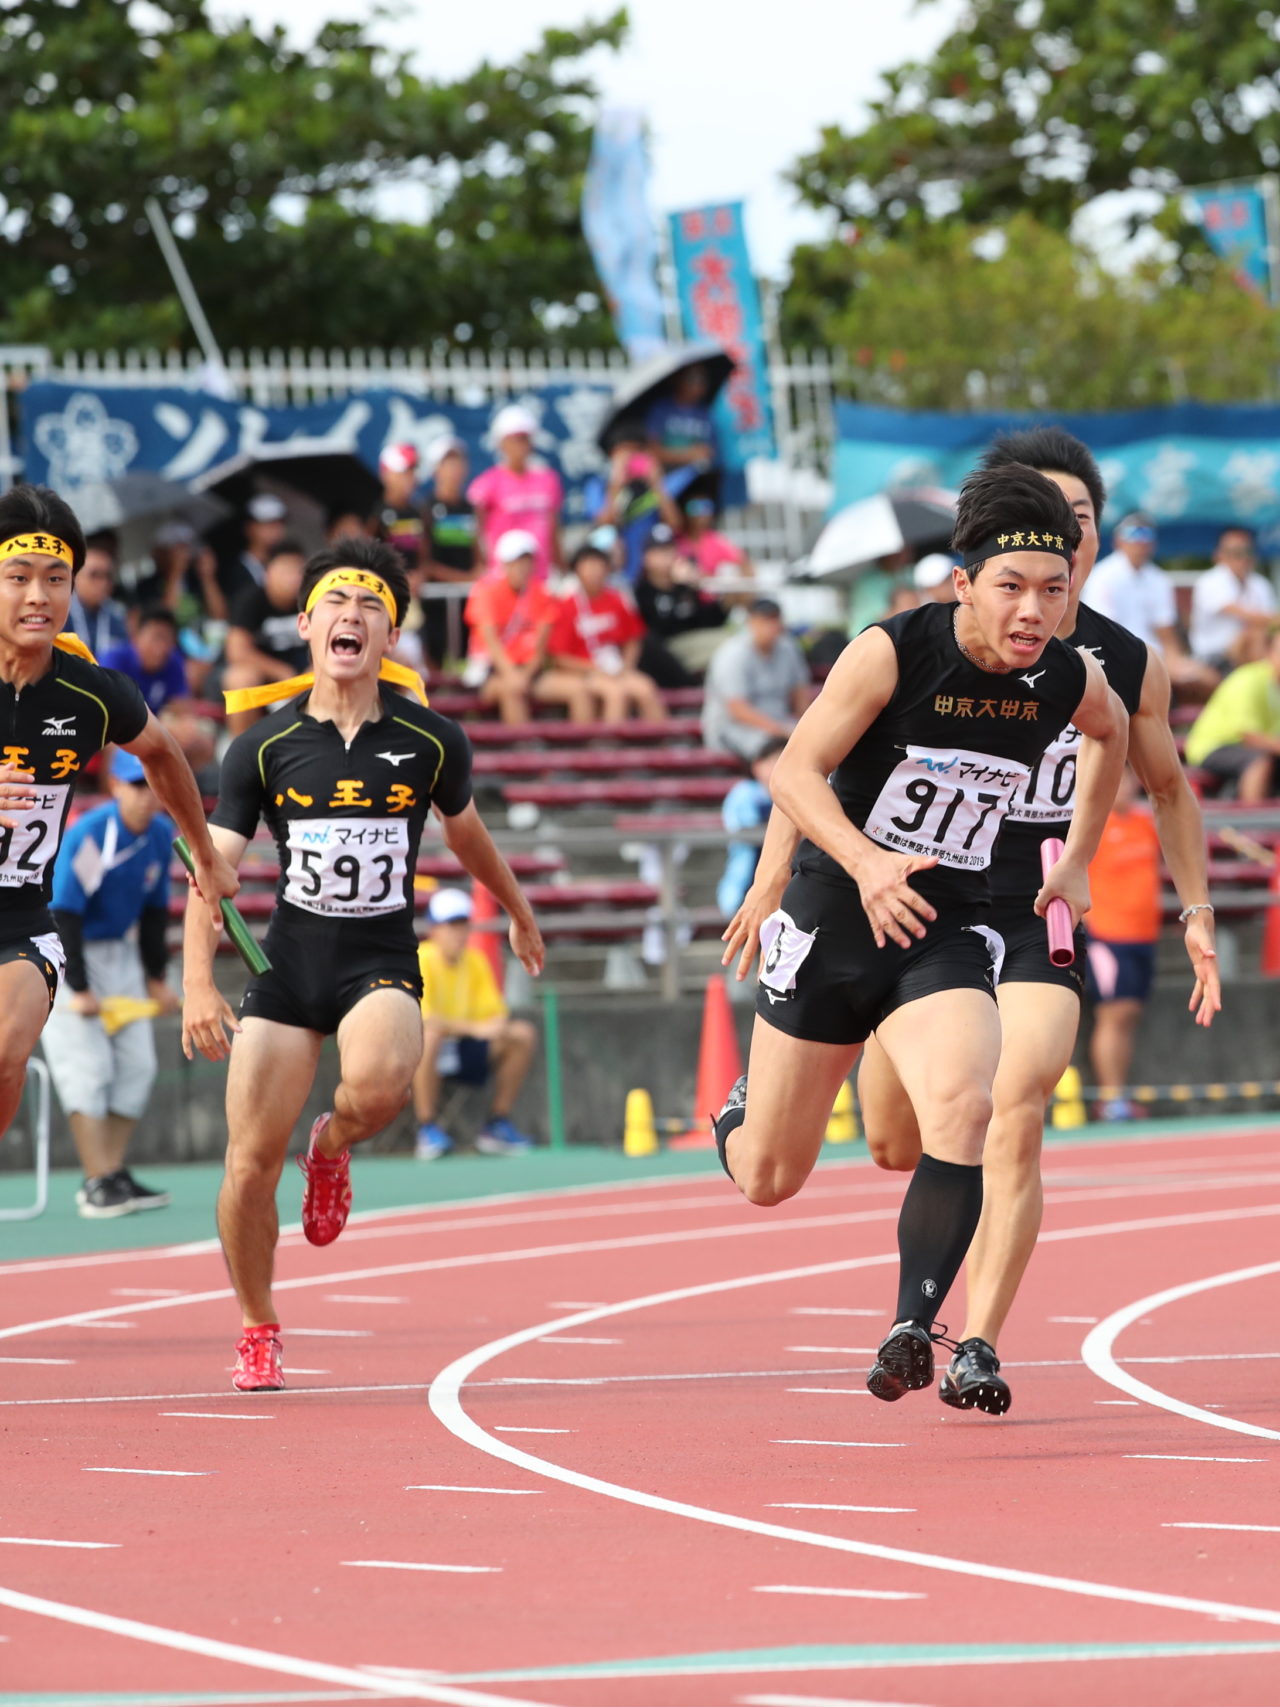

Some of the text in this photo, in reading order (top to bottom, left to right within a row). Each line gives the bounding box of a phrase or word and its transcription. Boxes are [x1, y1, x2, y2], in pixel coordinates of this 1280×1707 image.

[7, 536, 66, 555] 八王子
[997, 531, 1065, 551] 中京大中京
[934, 694, 1040, 721] 中京大中京
[959, 761, 1021, 787] マイナビ
[274, 780, 417, 813] 八王子
[890, 777, 1001, 850] 917
[335, 826, 400, 845] マイナビ
[884, 831, 931, 856] 感動は無限大
[969, 855, 985, 867] 2019
[301, 850, 394, 903] 593
